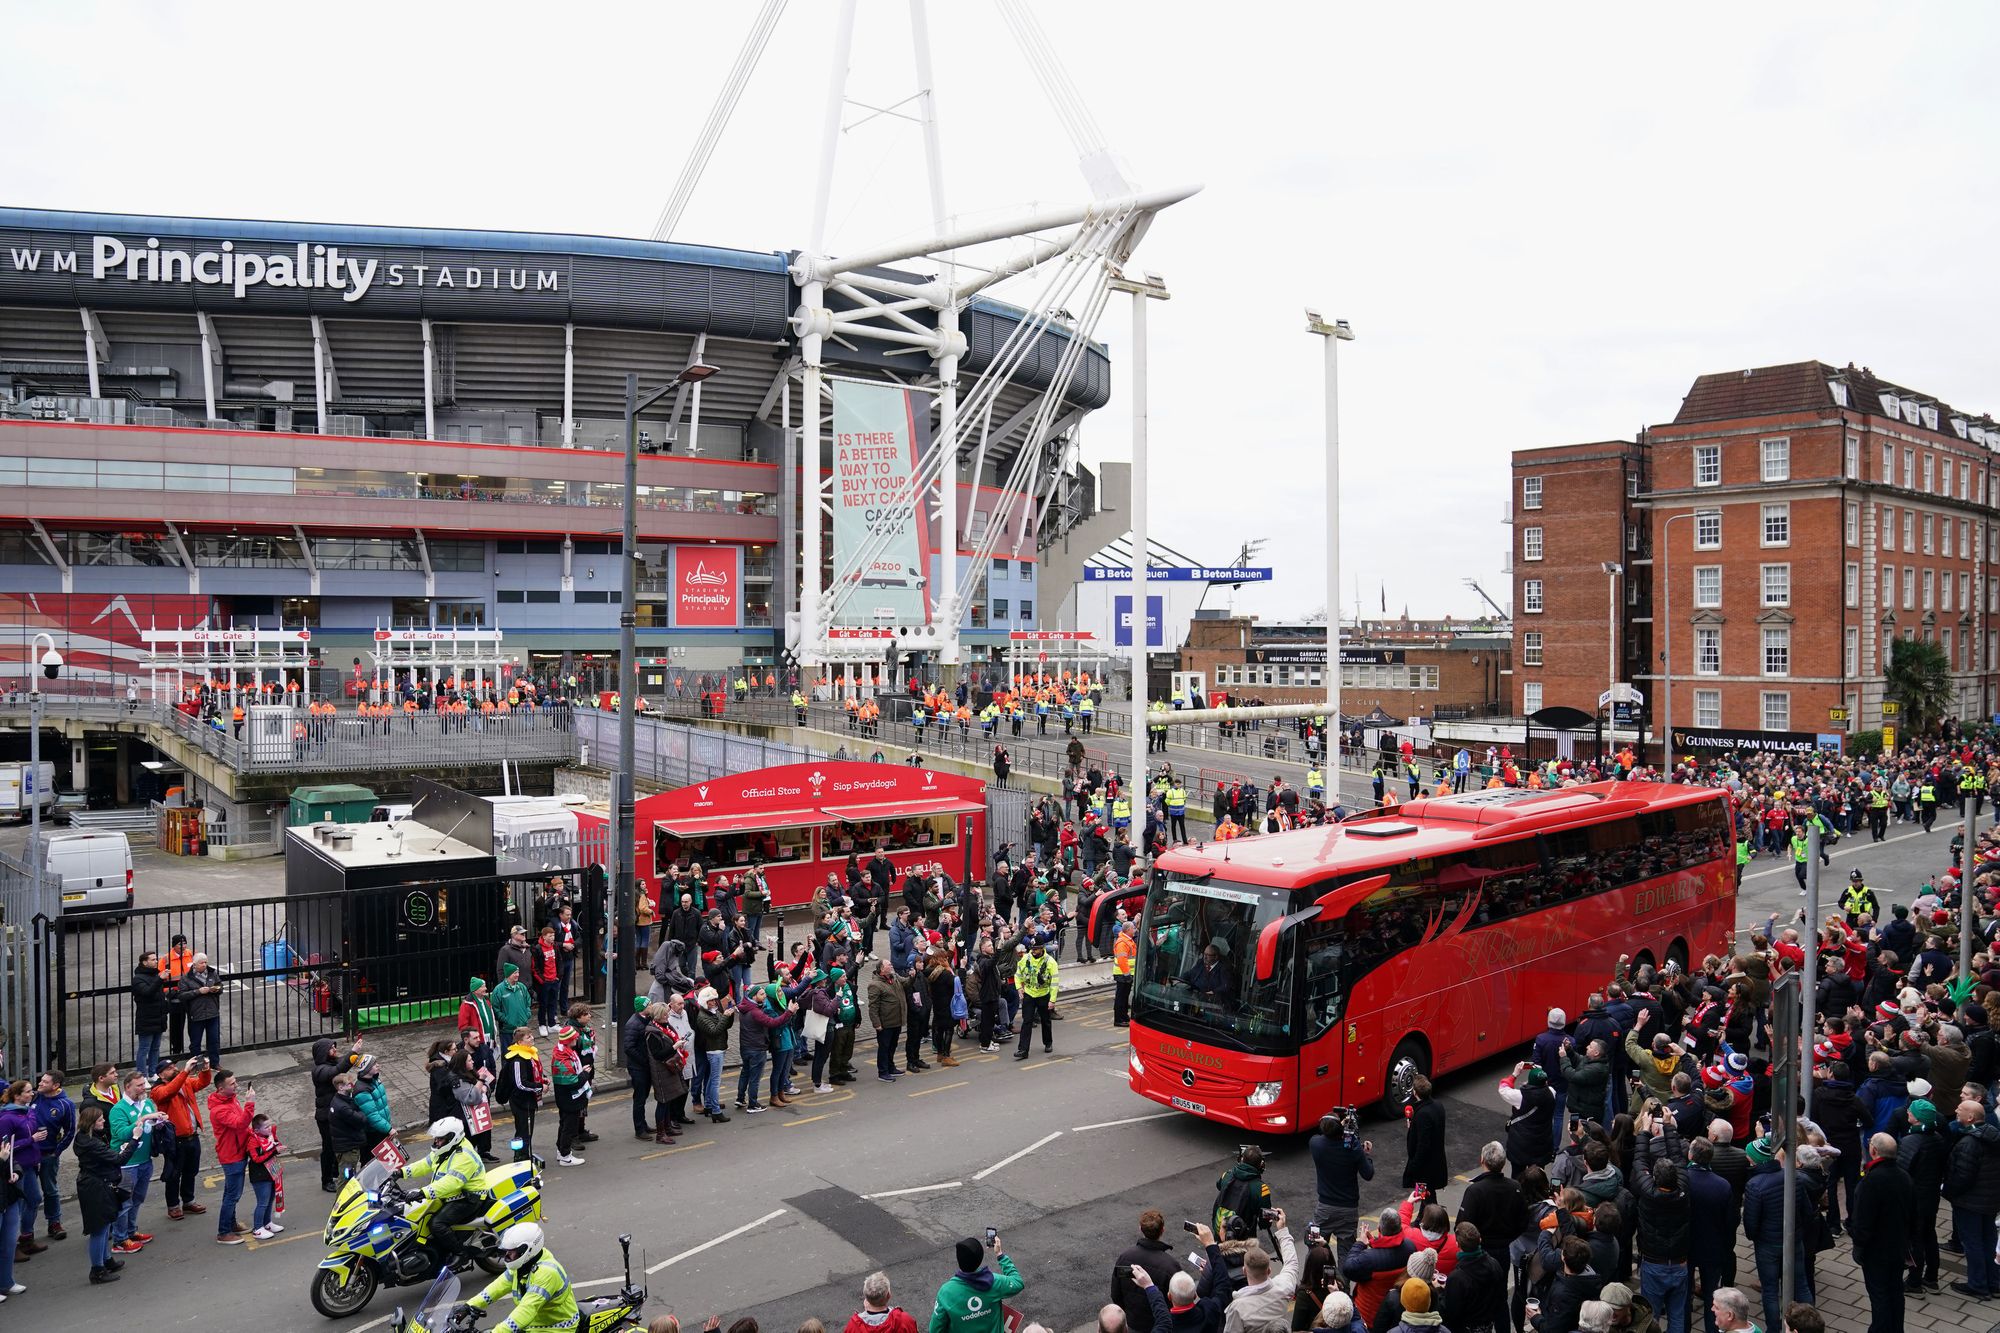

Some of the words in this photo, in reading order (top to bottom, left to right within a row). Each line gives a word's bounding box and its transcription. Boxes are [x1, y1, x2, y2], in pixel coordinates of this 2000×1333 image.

[93, 236, 379, 302] Principality
[389, 264, 559, 292] STADIUM
[838, 434, 852, 446] IS
[855, 432, 896, 446] THERE
[840, 448, 848, 461] A
[852, 447, 898, 461] BETTER
[840, 463, 868, 476] WAY
[872, 462, 890, 474] TO
[842, 478, 867, 492] BUY
[871, 476, 906, 490] YOUR
[843, 493, 876, 507] NEXT
[1107, 569, 1132, 578] Beto
[1147, 570, 1168, 578] auen
[1203, 569, 1232, 578] Beton
[1234, 570, 1262, 578] Bauen
[682, 594, 730, 606] Principality
[1686, 736, 1734, 748] GUINNESS
[1737, 739, 1760, 749] FAN
[1762, 741, 1812, 752] VILLAGE
[833, 782, 852, 792] Siop
[854, 778, 897, 790] Swyddogol
[741, 788, 776, 799] Official
[777, 787, 801, 796] Store
[1634, 874, 1706, 916] EDWARDS
[1160, 1043, 1223, 1069] EDWARDS
[1192, 1102, 1204, 1113] WRU
[378, 1142, 403, 1171] TRY
[594, 1311, 622, 1333] POLICE
[961, 1309, 992, 1321] vodafone
